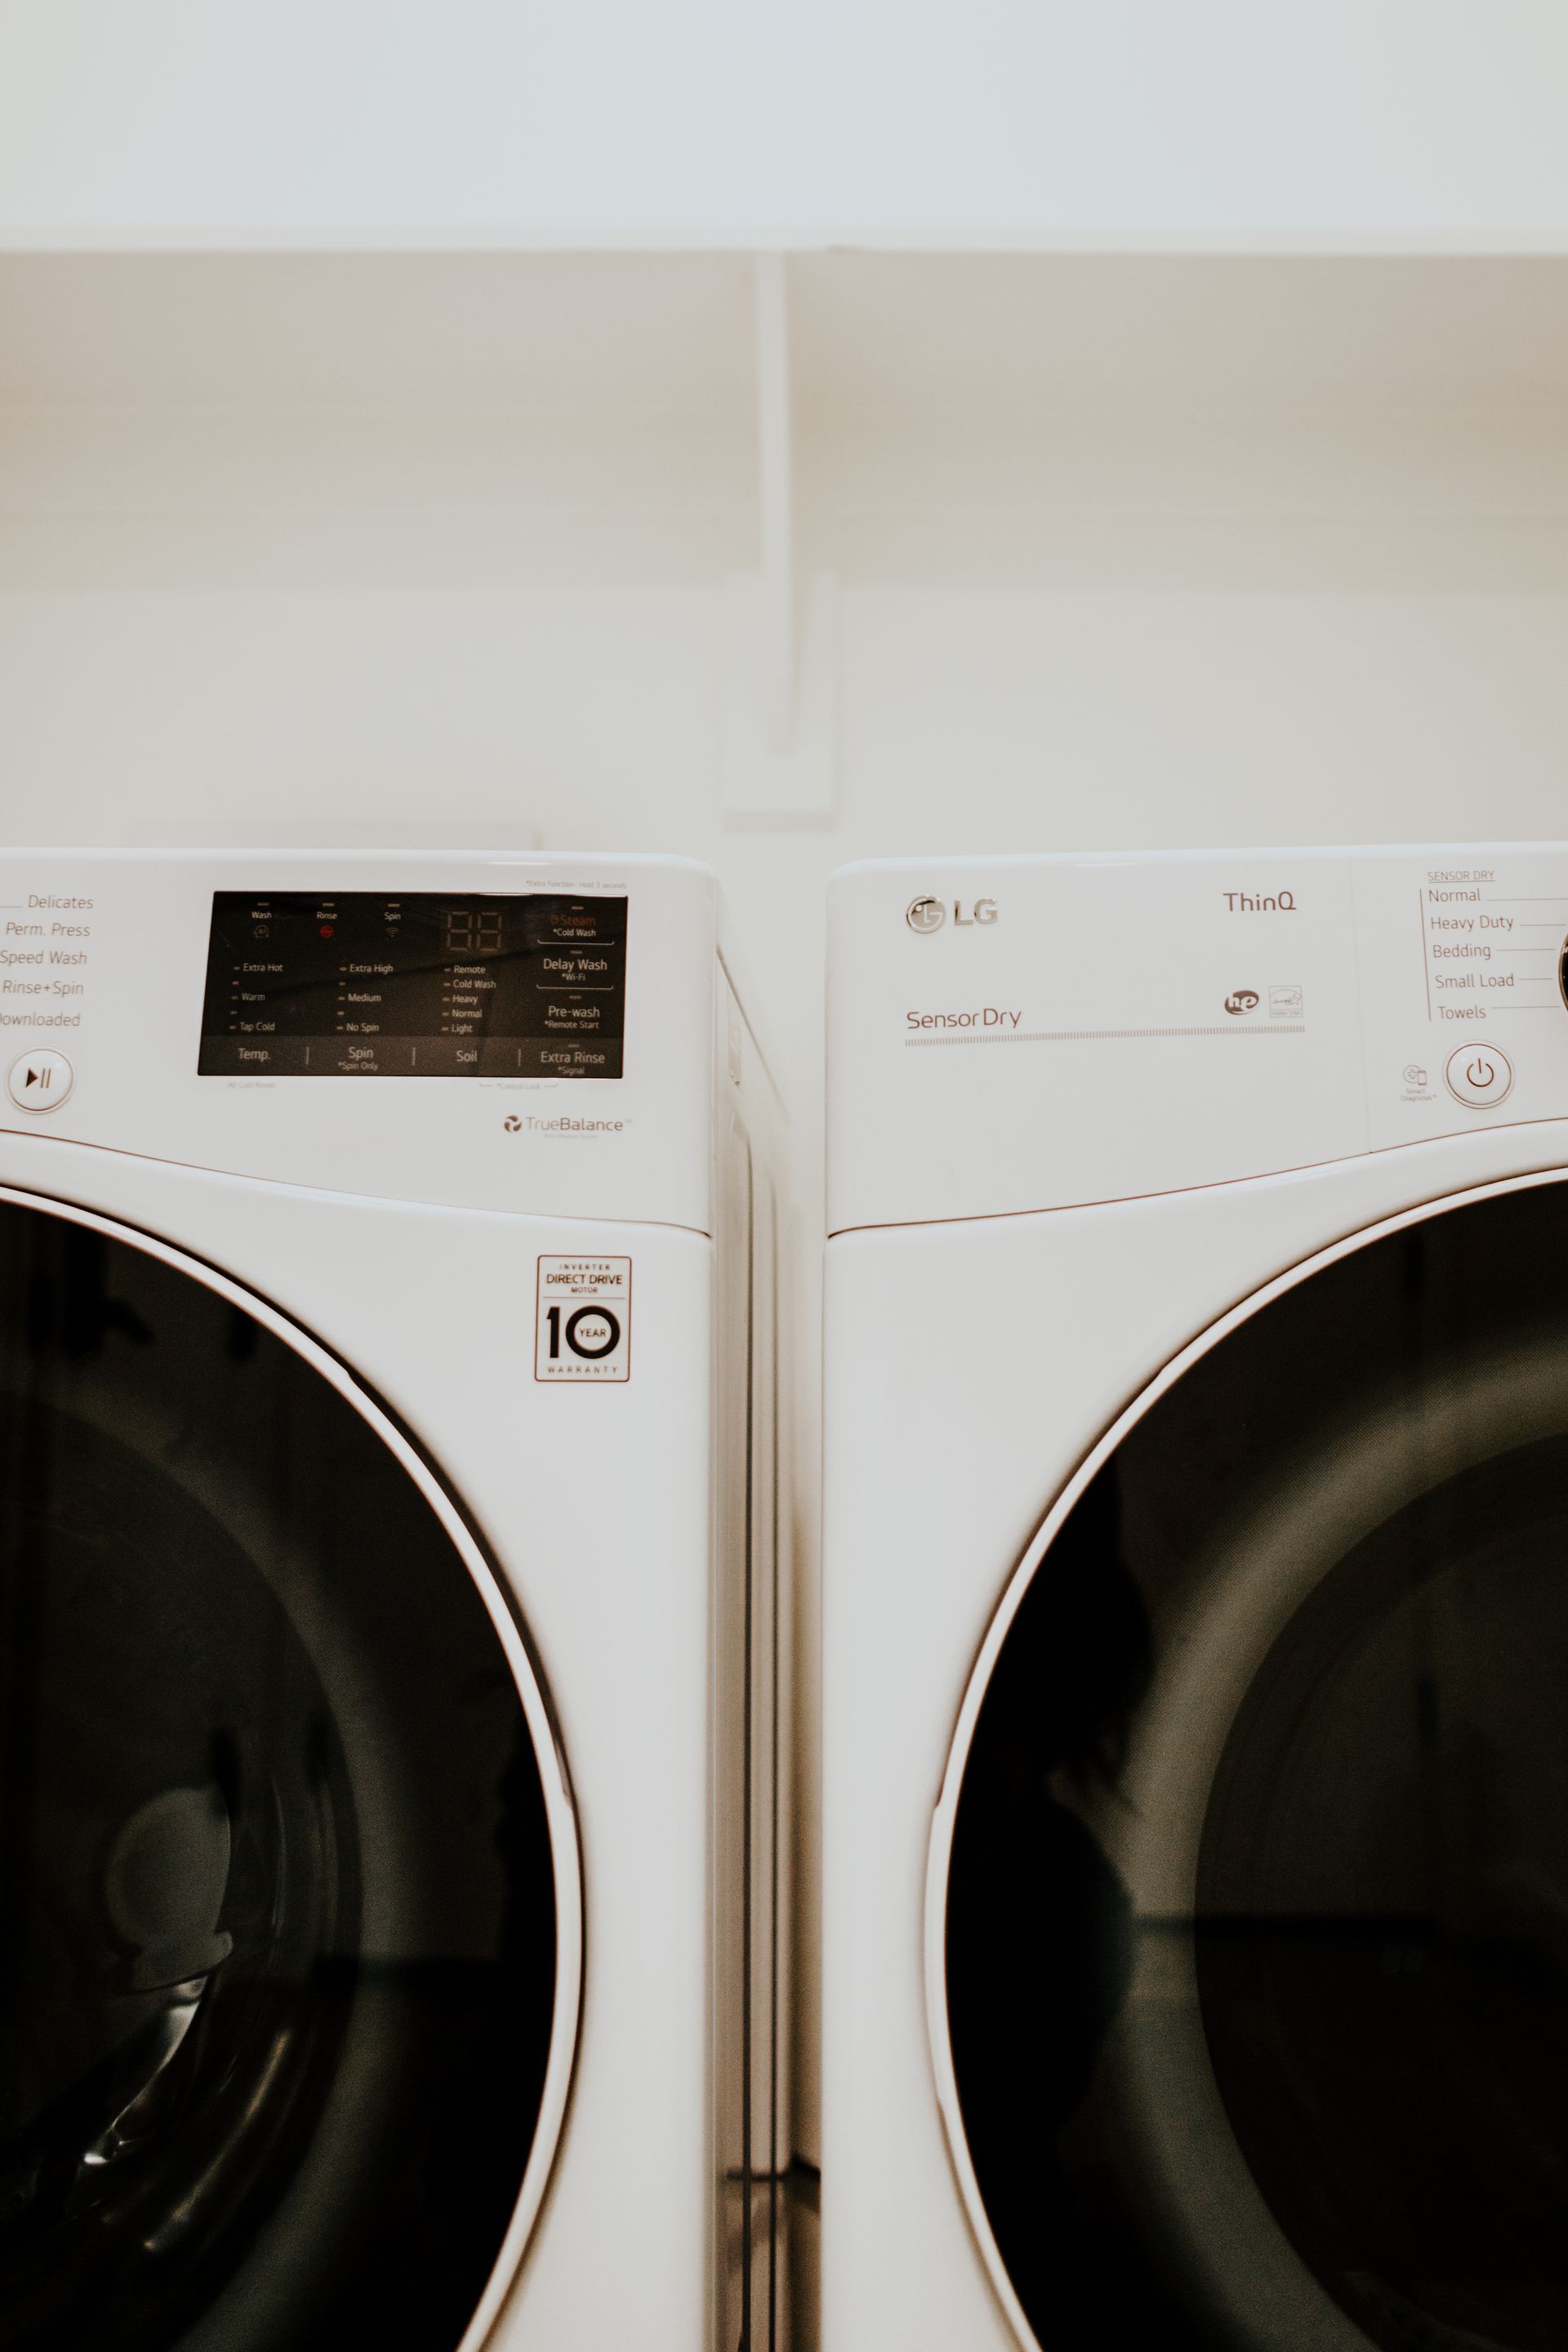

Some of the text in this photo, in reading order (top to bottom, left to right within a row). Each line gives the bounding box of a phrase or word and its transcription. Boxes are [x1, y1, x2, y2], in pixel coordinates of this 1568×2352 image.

[1428, 870, 1495, 881] SENSOR DRY
[1428, 888, 1481, 902] Normal
[28, 894, 94, 909] Delicates
[1223, 891, 1297, 912] ThinQ
[317, 911, 337, 920] Rinse
[384, 911, 402, 921] Spin
[953, 898, 999, 926] LG
[562, 915, 596, 925] Steam
[1431, 915, 1514, 933] Heavy Duty
[6, 921, 91, 938] Perm. Press
[576, 928, 596, 937] Wash
[1432, 943, 1491, 960] Bedding
[0, 950, 87, 967] Speed Wash
[243, 963, 284, 972] Extra Hot
[349, 964, 394, 974] Extra High
[453, 965, 486, 974] Remote
[543, 958, 608, 973] Delay Wash
[452, 979, 497, 989] Cold Wash
[1435, 973, 1515, 989] Small Load
[2, 979, 84, 998] Rinse+Spin
[241, 992, 266, 1001] Warm
[347, 993, 382, 1002] Medium
[452, 994, 479, 1005] Heavy
[452, 1009, 483, 1019] Normal
[548, 1005, 600, 1018] Pre-wash
[1437, 1005, 1486, 1020] Towels
[239, 1022, 276, 1032] Tap Cold
[346, 1022, 380, 1033] No Spin
[451, 1023, 474, 1035] Light
[578, 1021, 599, 1030] Start
[238, 1048, 272, 1061] Temp.
[348, 1047, 374, 1060] Spin
[456, 1049, 479, 1062] Soil
[540, 1051, 606, 1064] Extra Rinse
[360, 1061, 379, 1071] Only
[559, 1263, 612, 1271] INVERTER
[546, 1273, 623, 1285] DIRECT DRIVE
[570, 1285, 599, 1294] MOTOR
[546, 1304, 621, 1360] 10
[578, 1327, 607, 1338] YEAR
[546, 1365, 619, 1374] WARRANTY
